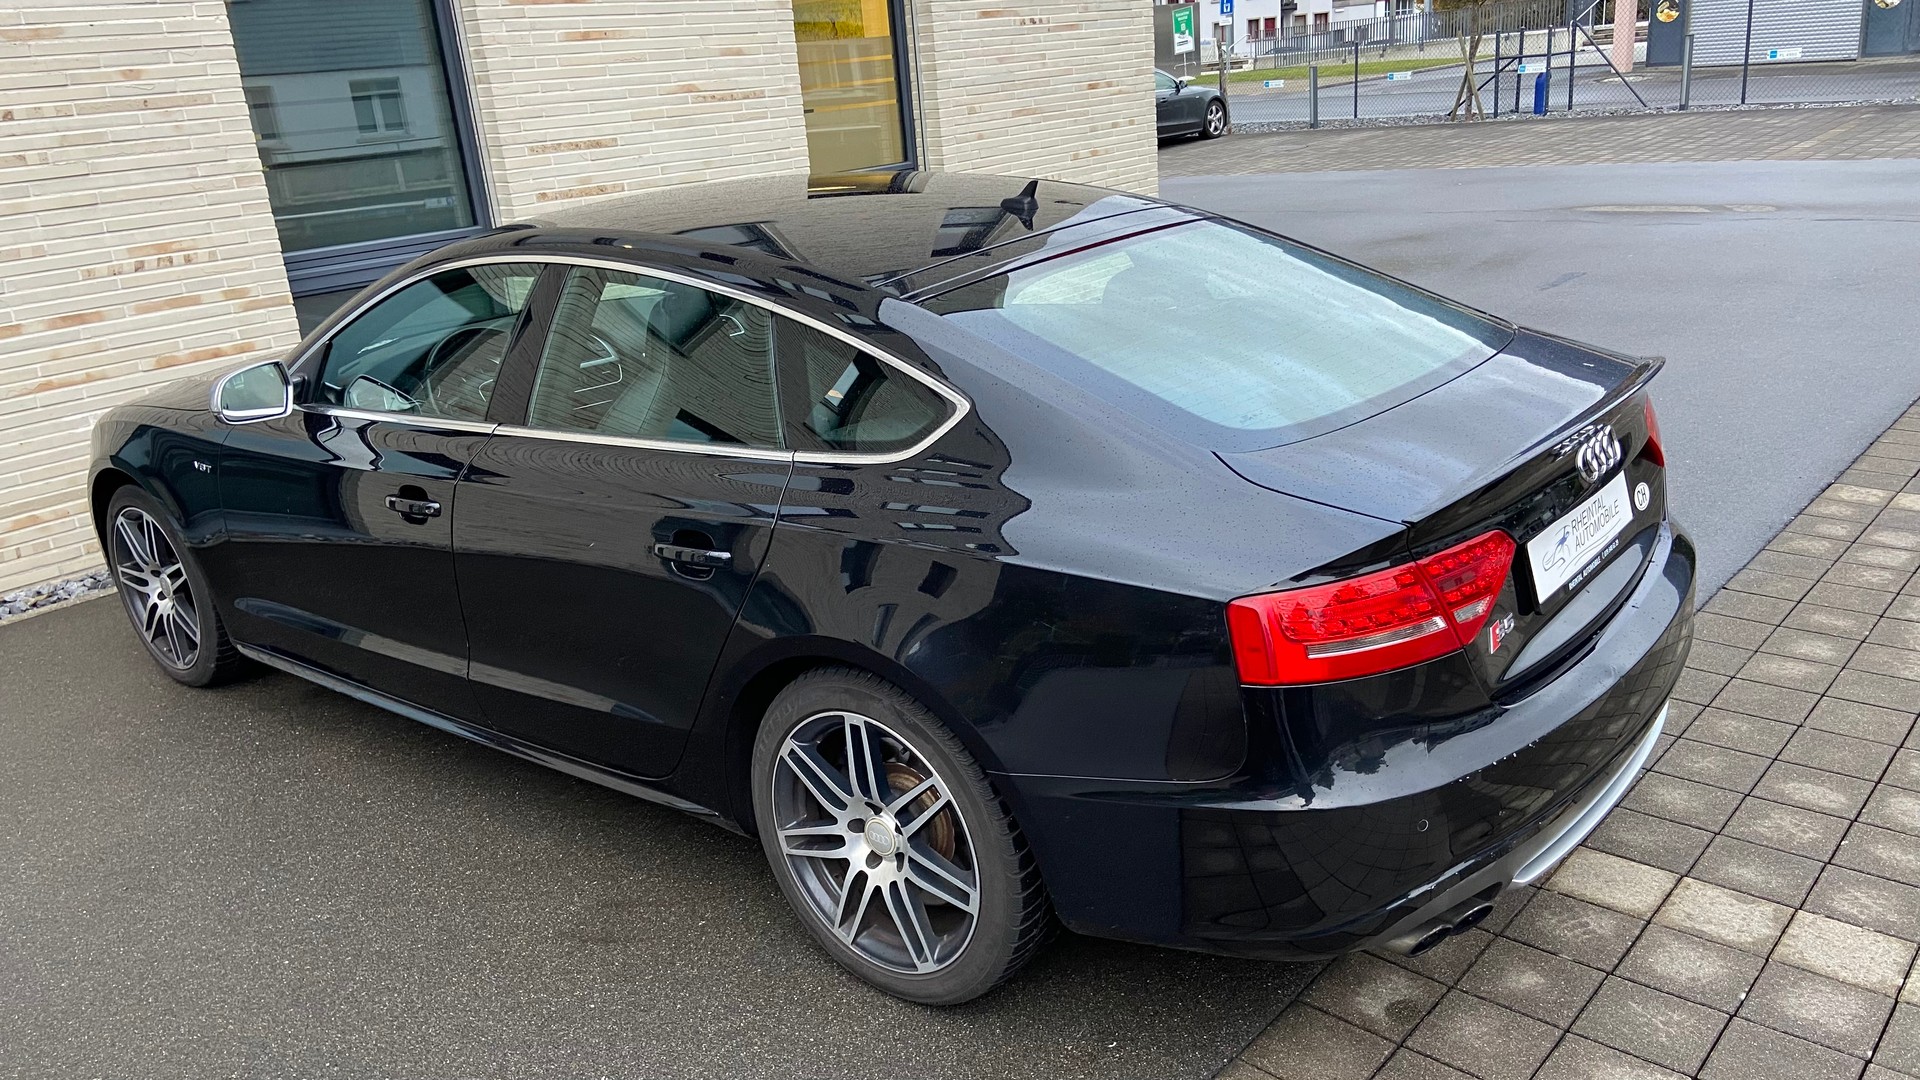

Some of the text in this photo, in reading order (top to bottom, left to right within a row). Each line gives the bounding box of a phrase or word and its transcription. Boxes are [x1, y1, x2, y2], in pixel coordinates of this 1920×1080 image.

[1636, 486, 1648, 507] CH
[1571, 495, 1606, 535] RHEINTAL
[1575, 499, 1620, 552] AUTOMOBILE
[1495, 612, 1515, 642] S5
